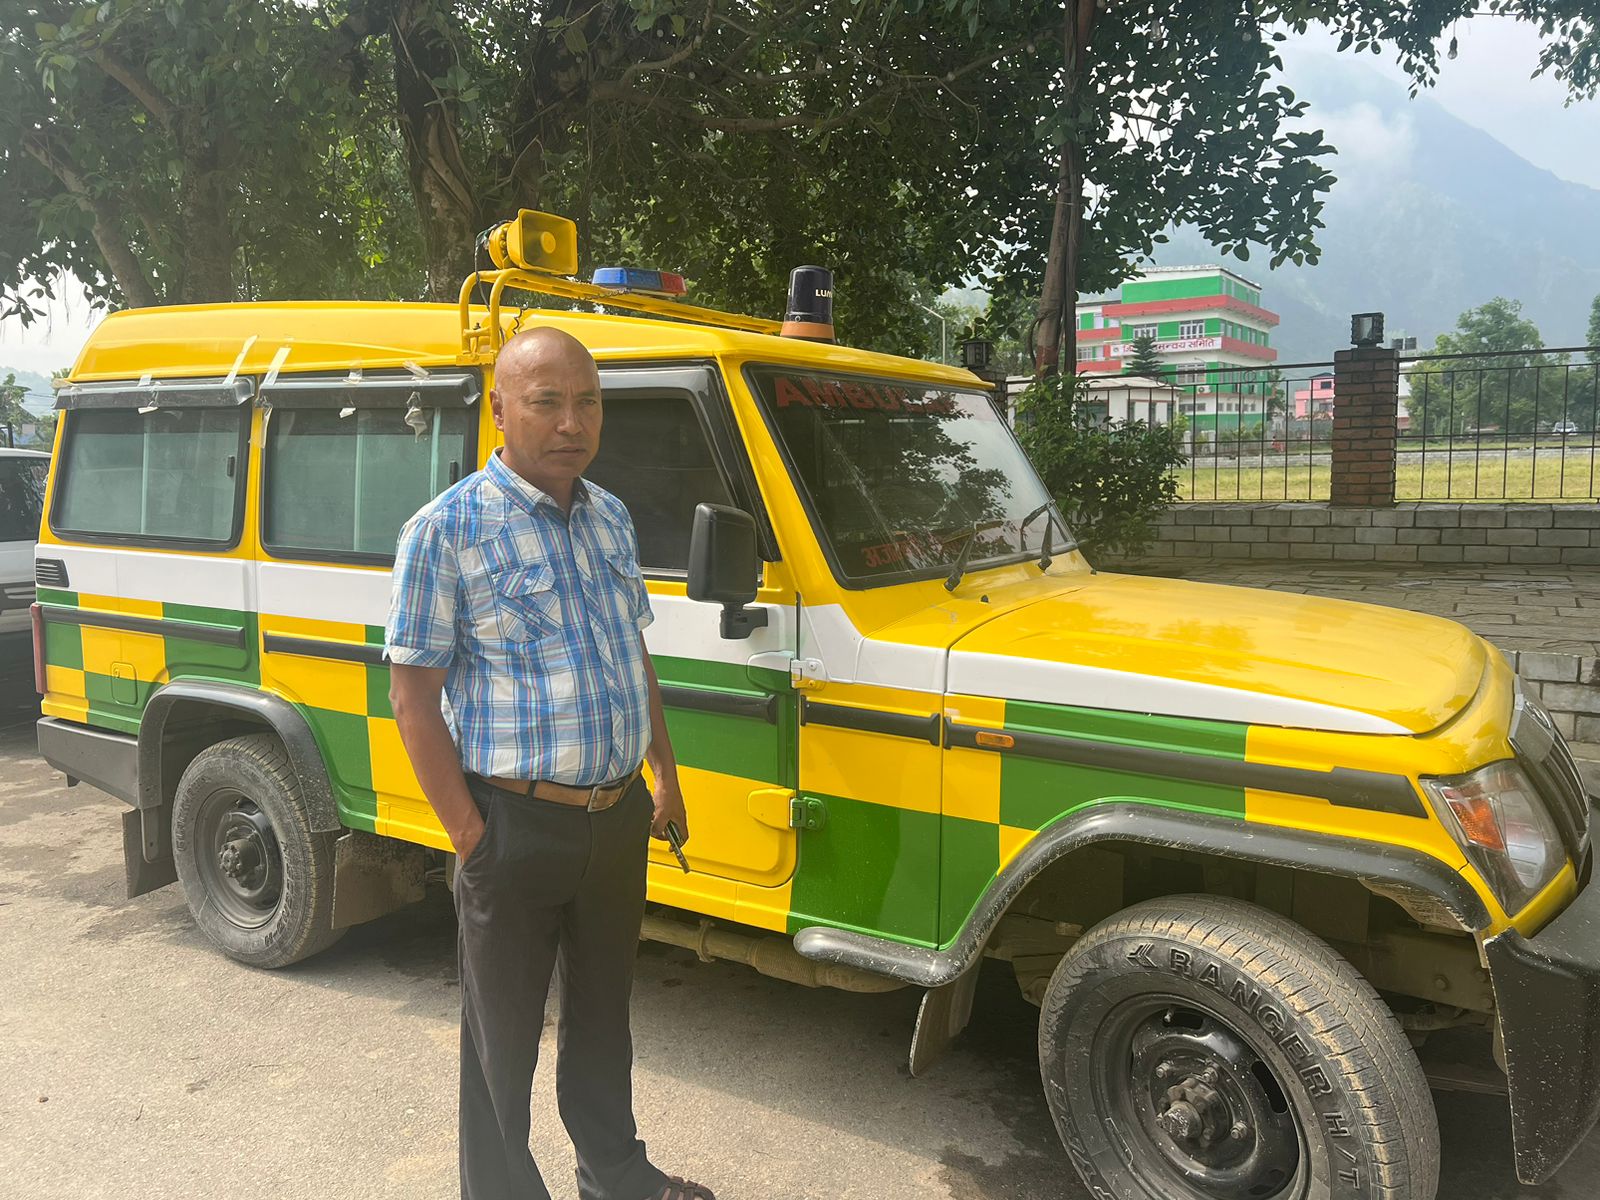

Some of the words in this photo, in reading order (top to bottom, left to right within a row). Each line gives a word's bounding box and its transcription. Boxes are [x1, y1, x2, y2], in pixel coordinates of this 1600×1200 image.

[1154, 342, 1186, 352] मन्वय
[1188, 337, 1216, 348] समिति
[1169, 946, 1333, 1097] RANGER
